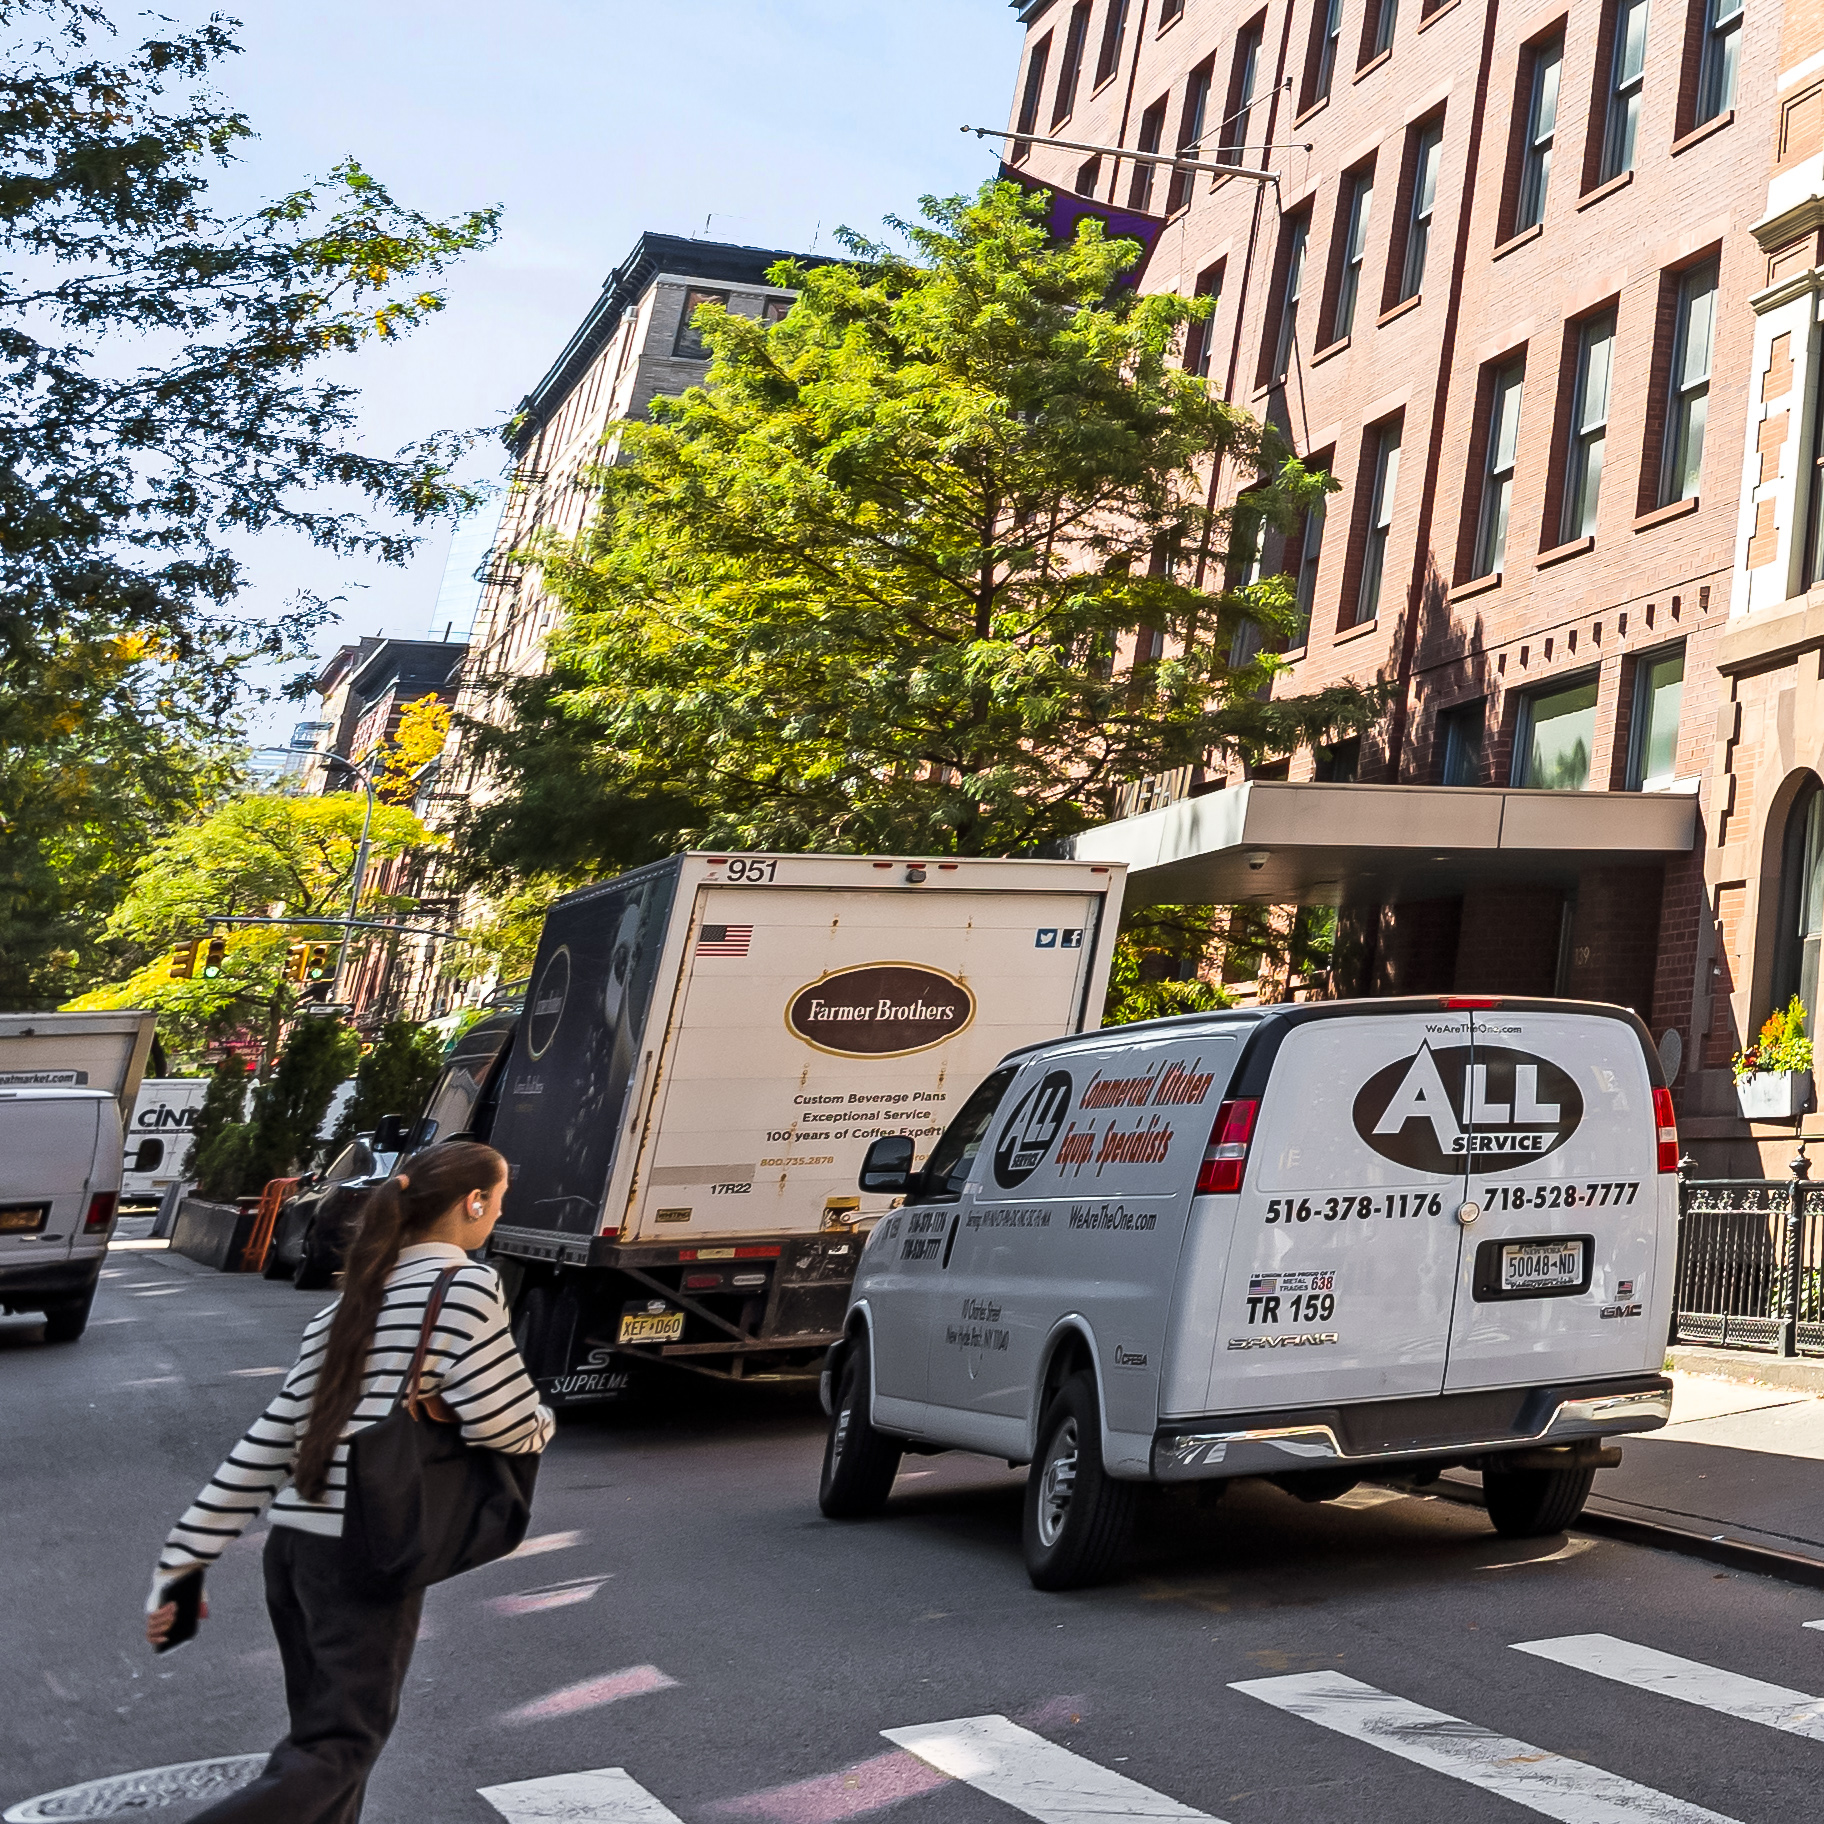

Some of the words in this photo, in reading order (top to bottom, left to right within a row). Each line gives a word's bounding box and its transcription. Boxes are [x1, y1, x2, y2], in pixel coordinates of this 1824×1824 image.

[726, 859, 779, 883] 951
[807, 999, 873, 1022] Farmer
[875, 999, 956, 1021] Brothers
[1425, 1023, 1522, 1034] WeAreTheOne.com
[1079, 1061, 1168, 1110] Commercial
[1151, 1057, 1215, 1106] Kitchen
[793, 1093, 845, 1105] Custom
[848, 1092, 909, 1105] Beverage
[913, 1092, 947, 1102] Plans
[1372, 1037, 1561, 1153] ALL
[802, 1109, 880, 1123] Exceptional
[884, 1109, 931, 1121] Service
[999, 1067, 1067, 1153] ALL
[765, 1130, 792, 1142] 100
[795, 1130, 830, 1144] years
[834, 1127, 849, 1140] of
[852, 1127, 896, 1139] Coffee
[1452, 1135, 1543, 1153] SERVICE
[760, 1155, 834, 1167] 800.735.2878
[1011, 1153, 1039, 1169] SERVICE
[710, 1183, 752, 1195] 17R22
[1483, 1182, 1640, 1212] 718-528-7777
[1068, 1205, 1157, 1231] WeAreTheOne.com
[1265, 1193, 1442, 1224] 516-378-1176
[1311, 1276, 1334, 1291] 638
[1246, 1295, 1281, 1324] TR
[1290, 1293, 1335, 1323] 159
[1600, 1304, 1643, 1319] GMC
[1227, 1331, 1339, 1351] SAVANA
[551, 1374, 631, 1394] SUPREME
